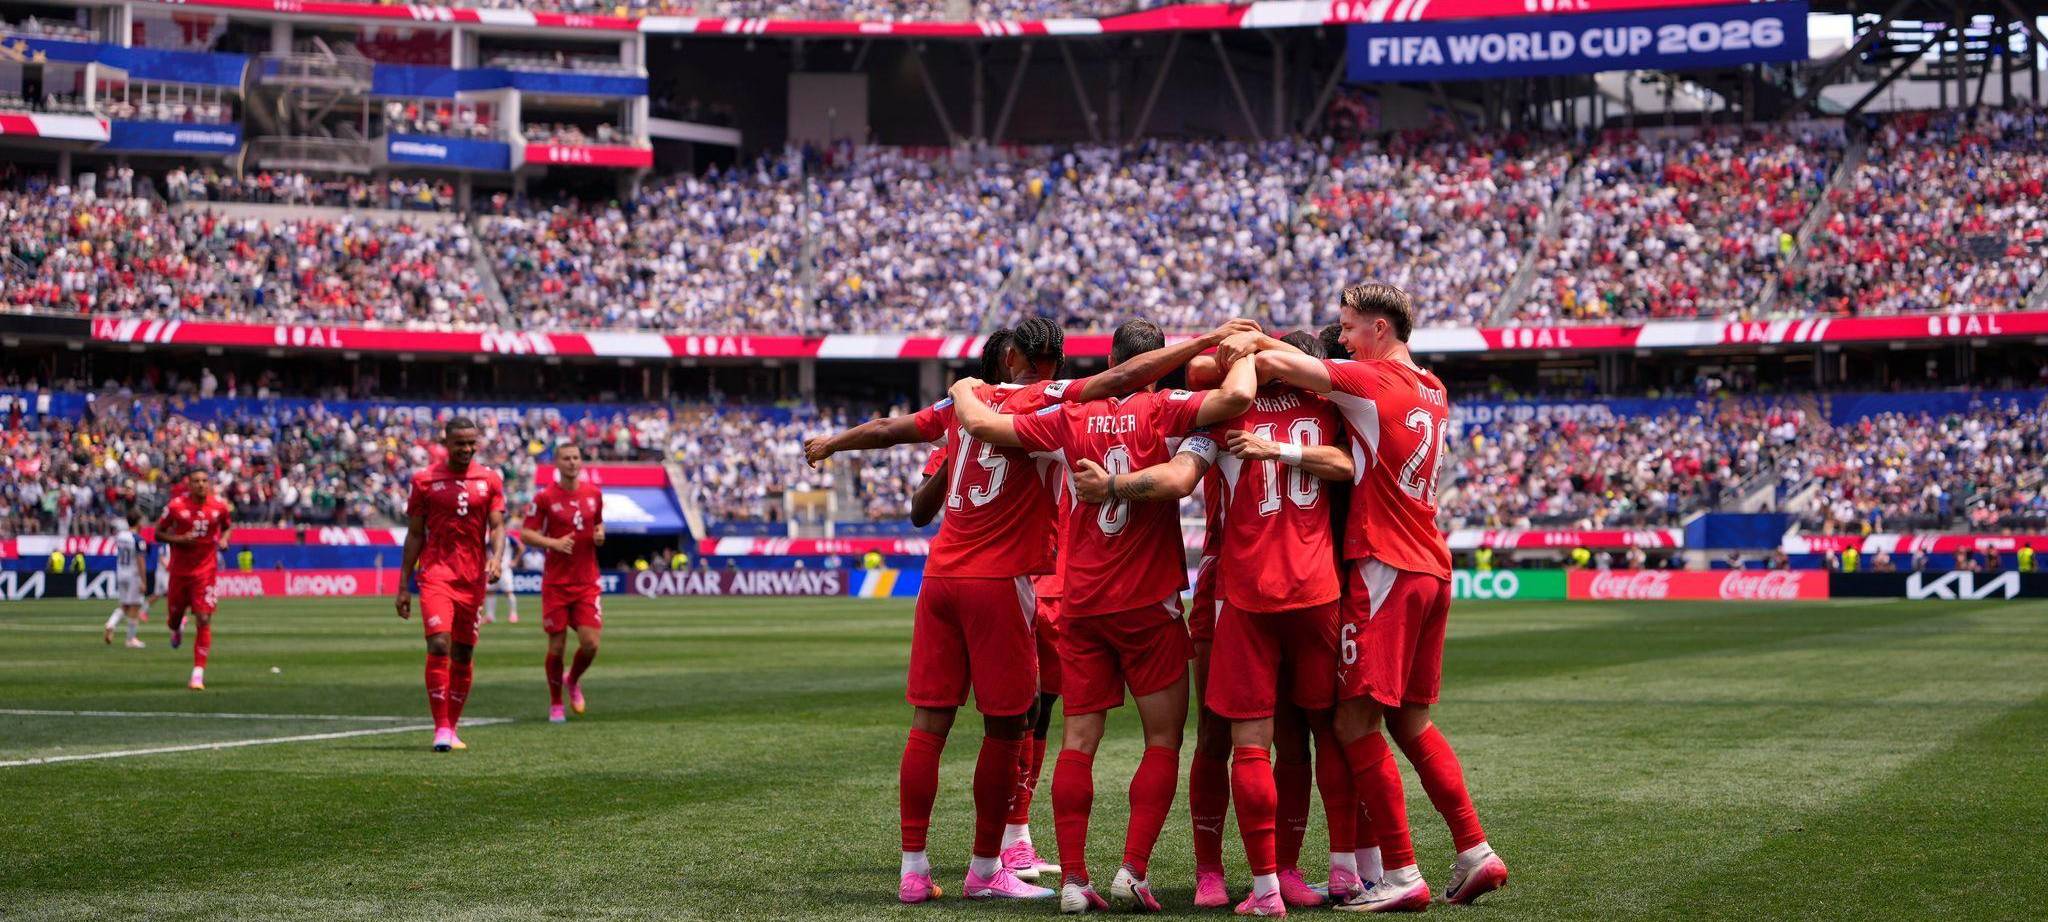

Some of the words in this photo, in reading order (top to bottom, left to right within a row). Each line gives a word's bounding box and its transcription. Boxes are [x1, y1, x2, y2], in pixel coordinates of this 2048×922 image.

[1368, 36, 1444, 66] FIFA
[1447, 31, 1576, 63] WORLD
[1580, 26, 1652, 58] CUP
[1656, 17, 1785, 55] 2026
[273, 325, 343, 347] GOAL
[1501, 328, 1572, 348] GOAL
[1927, 314, 2002, 336] GOAL
[686, 336, 755, 355] GOAL
[1253, 393, 1301, 412] XHAKA
[946, 424, 1010, 511] 15
[1252, 418, 1323, 517] 10
[456, 492, 469, 516] 5
[76, 570, 118, 600] KI
[285, 571, 357, 596] Lenovo
[635, 569, 722, 598] QATAR
[729, 569, 842, 596] AIRWAYS
[1906, 570, 2020, 600] KIA
[1341, 623, 1357, 665] 6
